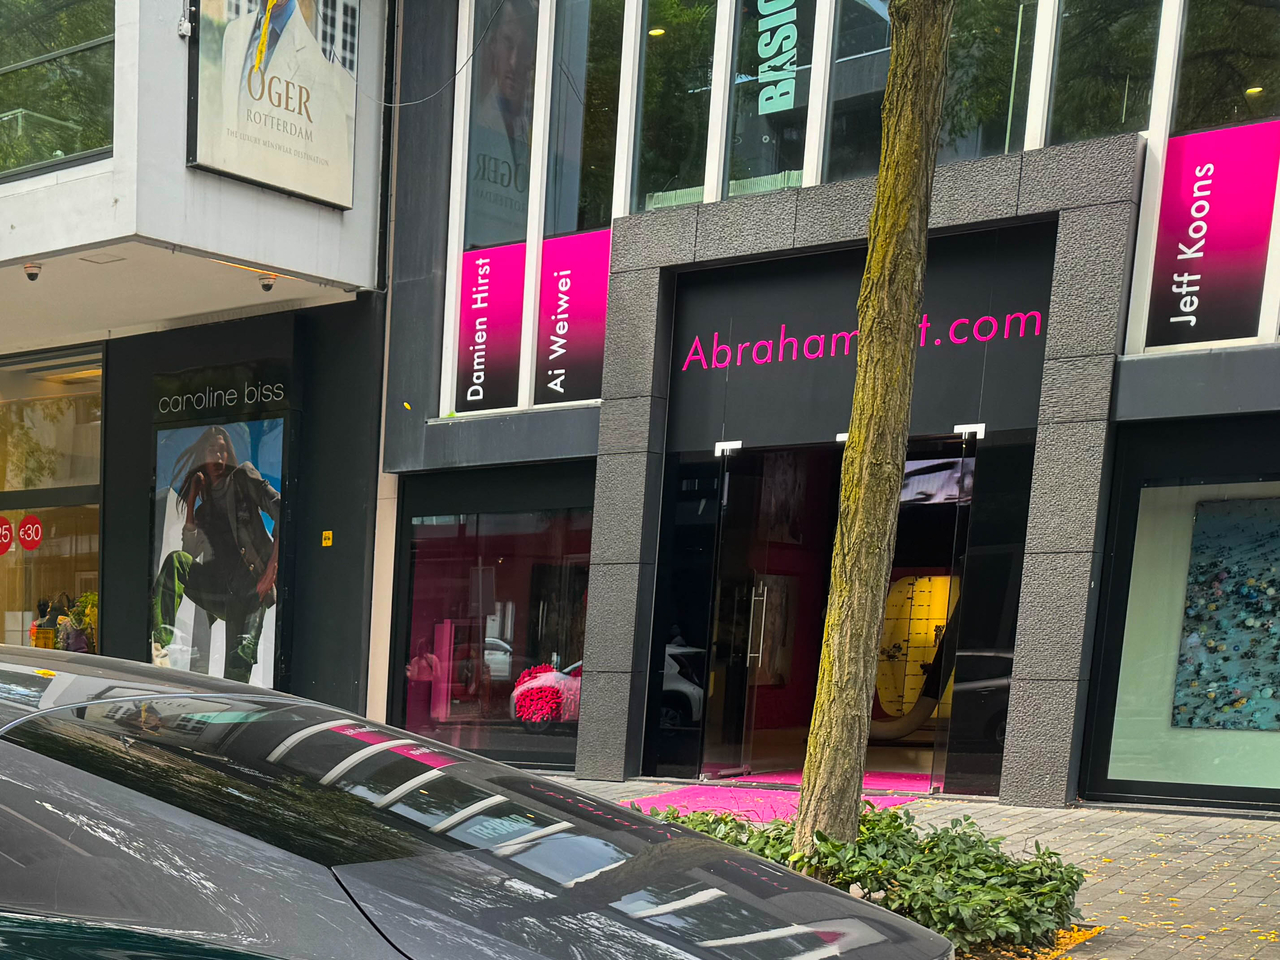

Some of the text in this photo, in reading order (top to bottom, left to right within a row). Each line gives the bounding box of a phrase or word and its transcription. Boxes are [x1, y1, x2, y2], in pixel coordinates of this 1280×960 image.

[247, 65, 314, 124] OGER
[227, 128, 329, 167] THE LUXURY MENSWEAR DESTINATION
[246, 108, 314, 142] ROTTERDAM
[1170, 163, 1215, 327] Jeff Koons
[467, 258, 490, 401] Damien Hirst
[547, 270, 572, 394] Ai Weiwei
[158, 381, 285, 413] caroline biss
[19, 524, 42, 541] €30
